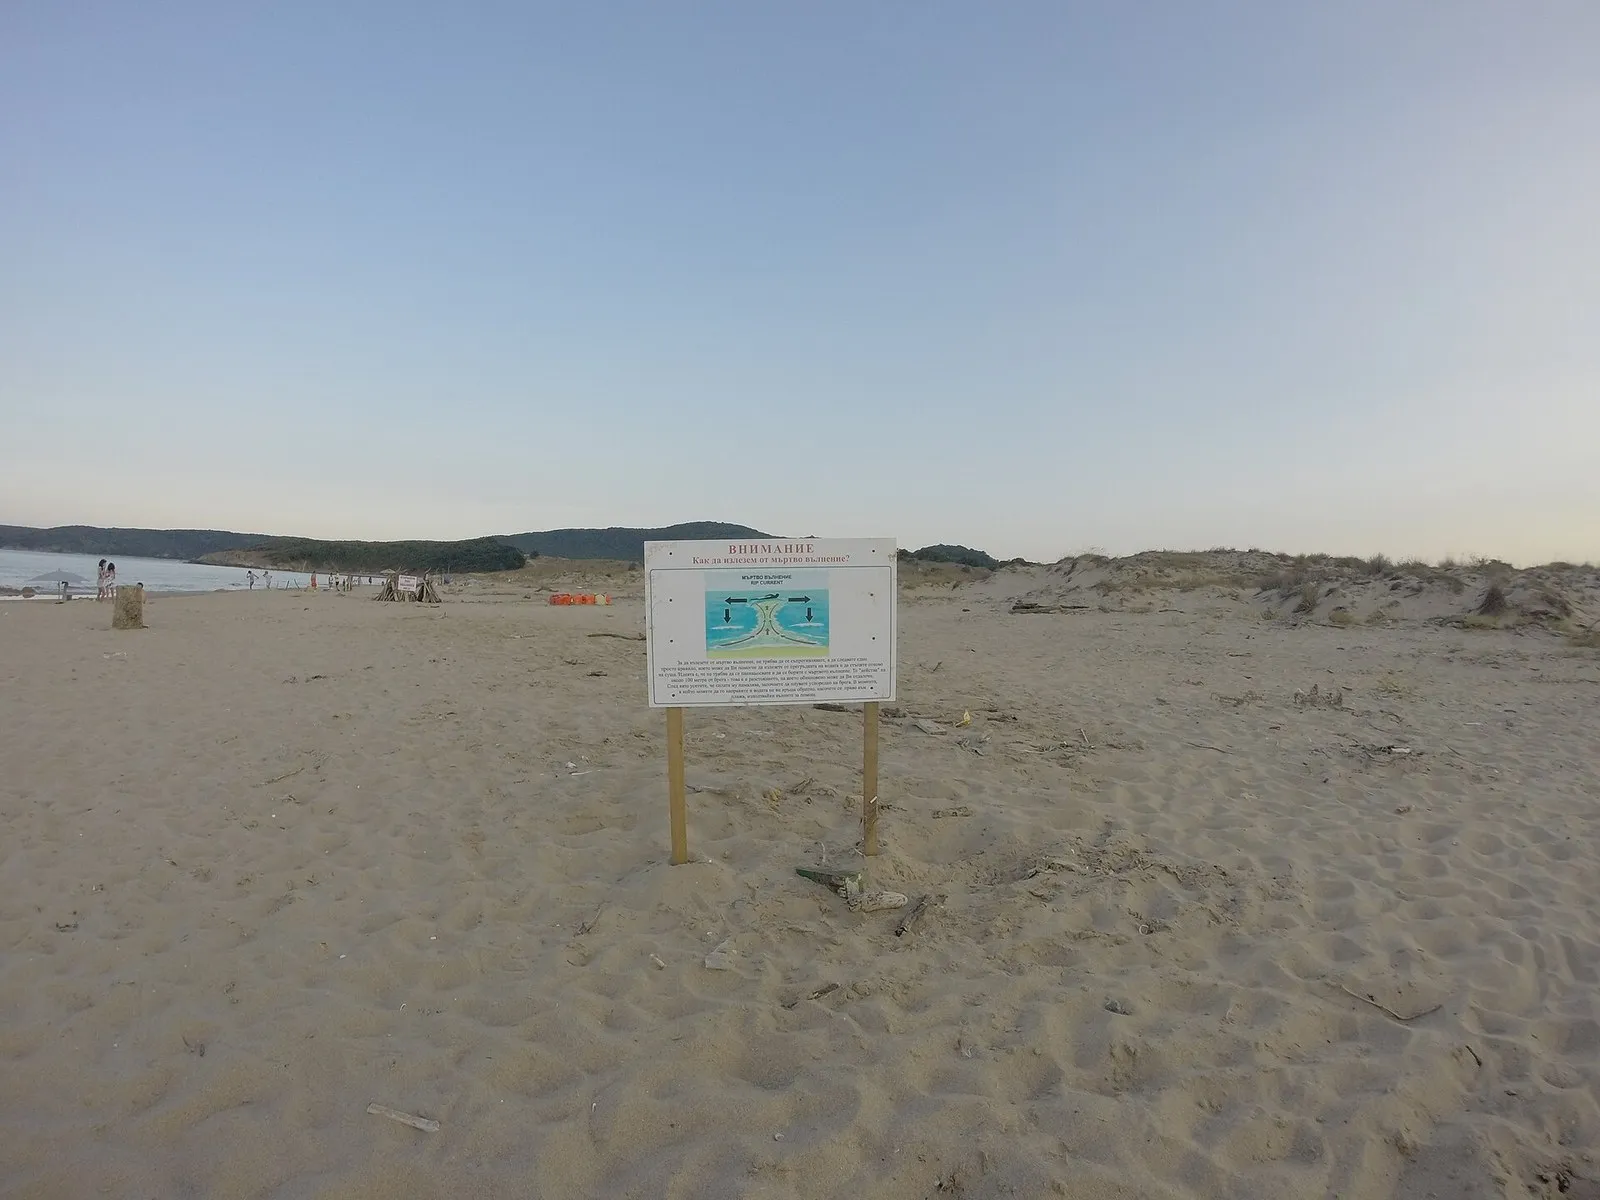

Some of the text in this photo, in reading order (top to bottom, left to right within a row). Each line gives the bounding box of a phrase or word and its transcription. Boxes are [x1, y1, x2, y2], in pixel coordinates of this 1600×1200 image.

[728, 544, 814, 554] ВНИМАНИЕ
[771, 557, 803, 565] мъртво
[805, 555, 850, 563] вълнение?
